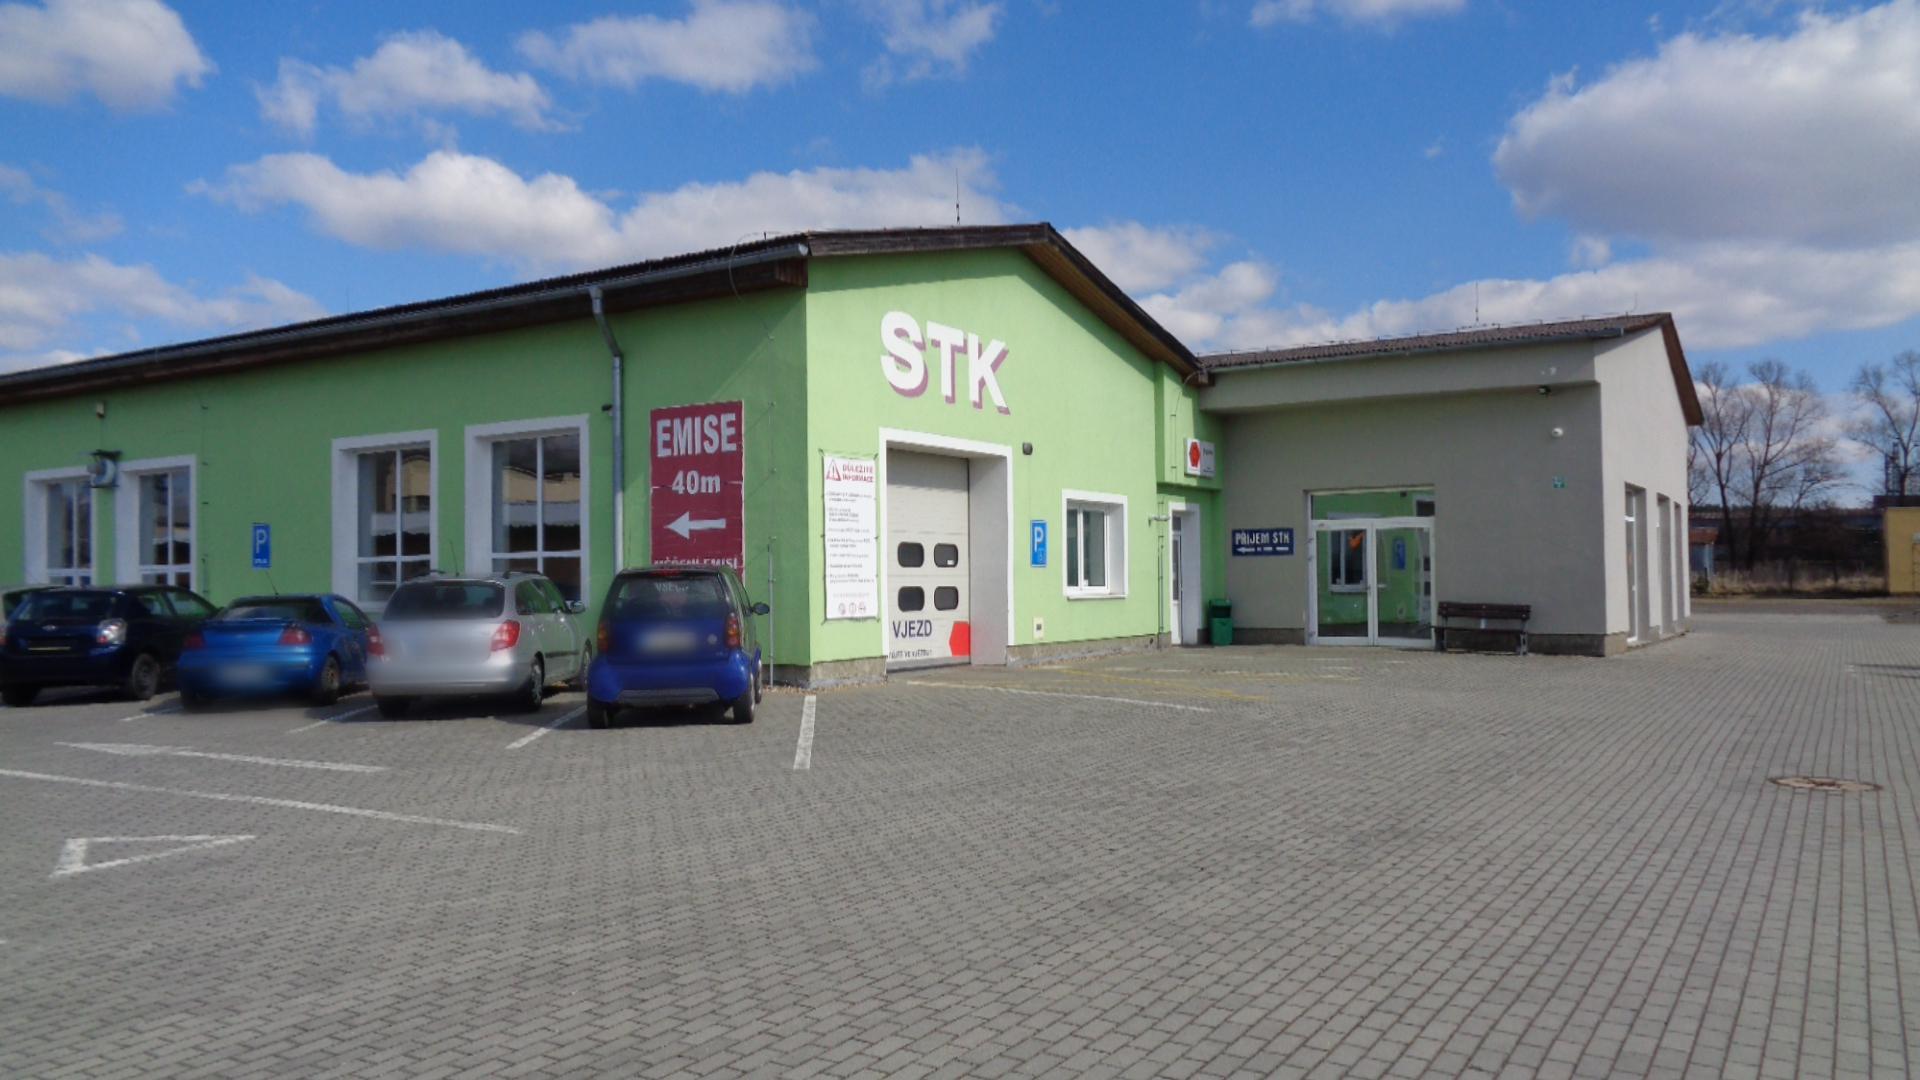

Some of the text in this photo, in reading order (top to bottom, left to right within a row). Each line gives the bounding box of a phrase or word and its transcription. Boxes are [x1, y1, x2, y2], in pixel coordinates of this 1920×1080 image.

[880, 311, 1011, 415] STK
[656, 412, 737, 458] EMISE
[671, 470, 721, 495] 40m
[255, 529, 268, 554] P
[1033, 526, 1045, 553] P
[892, 619, 933, 638] VJEZD
